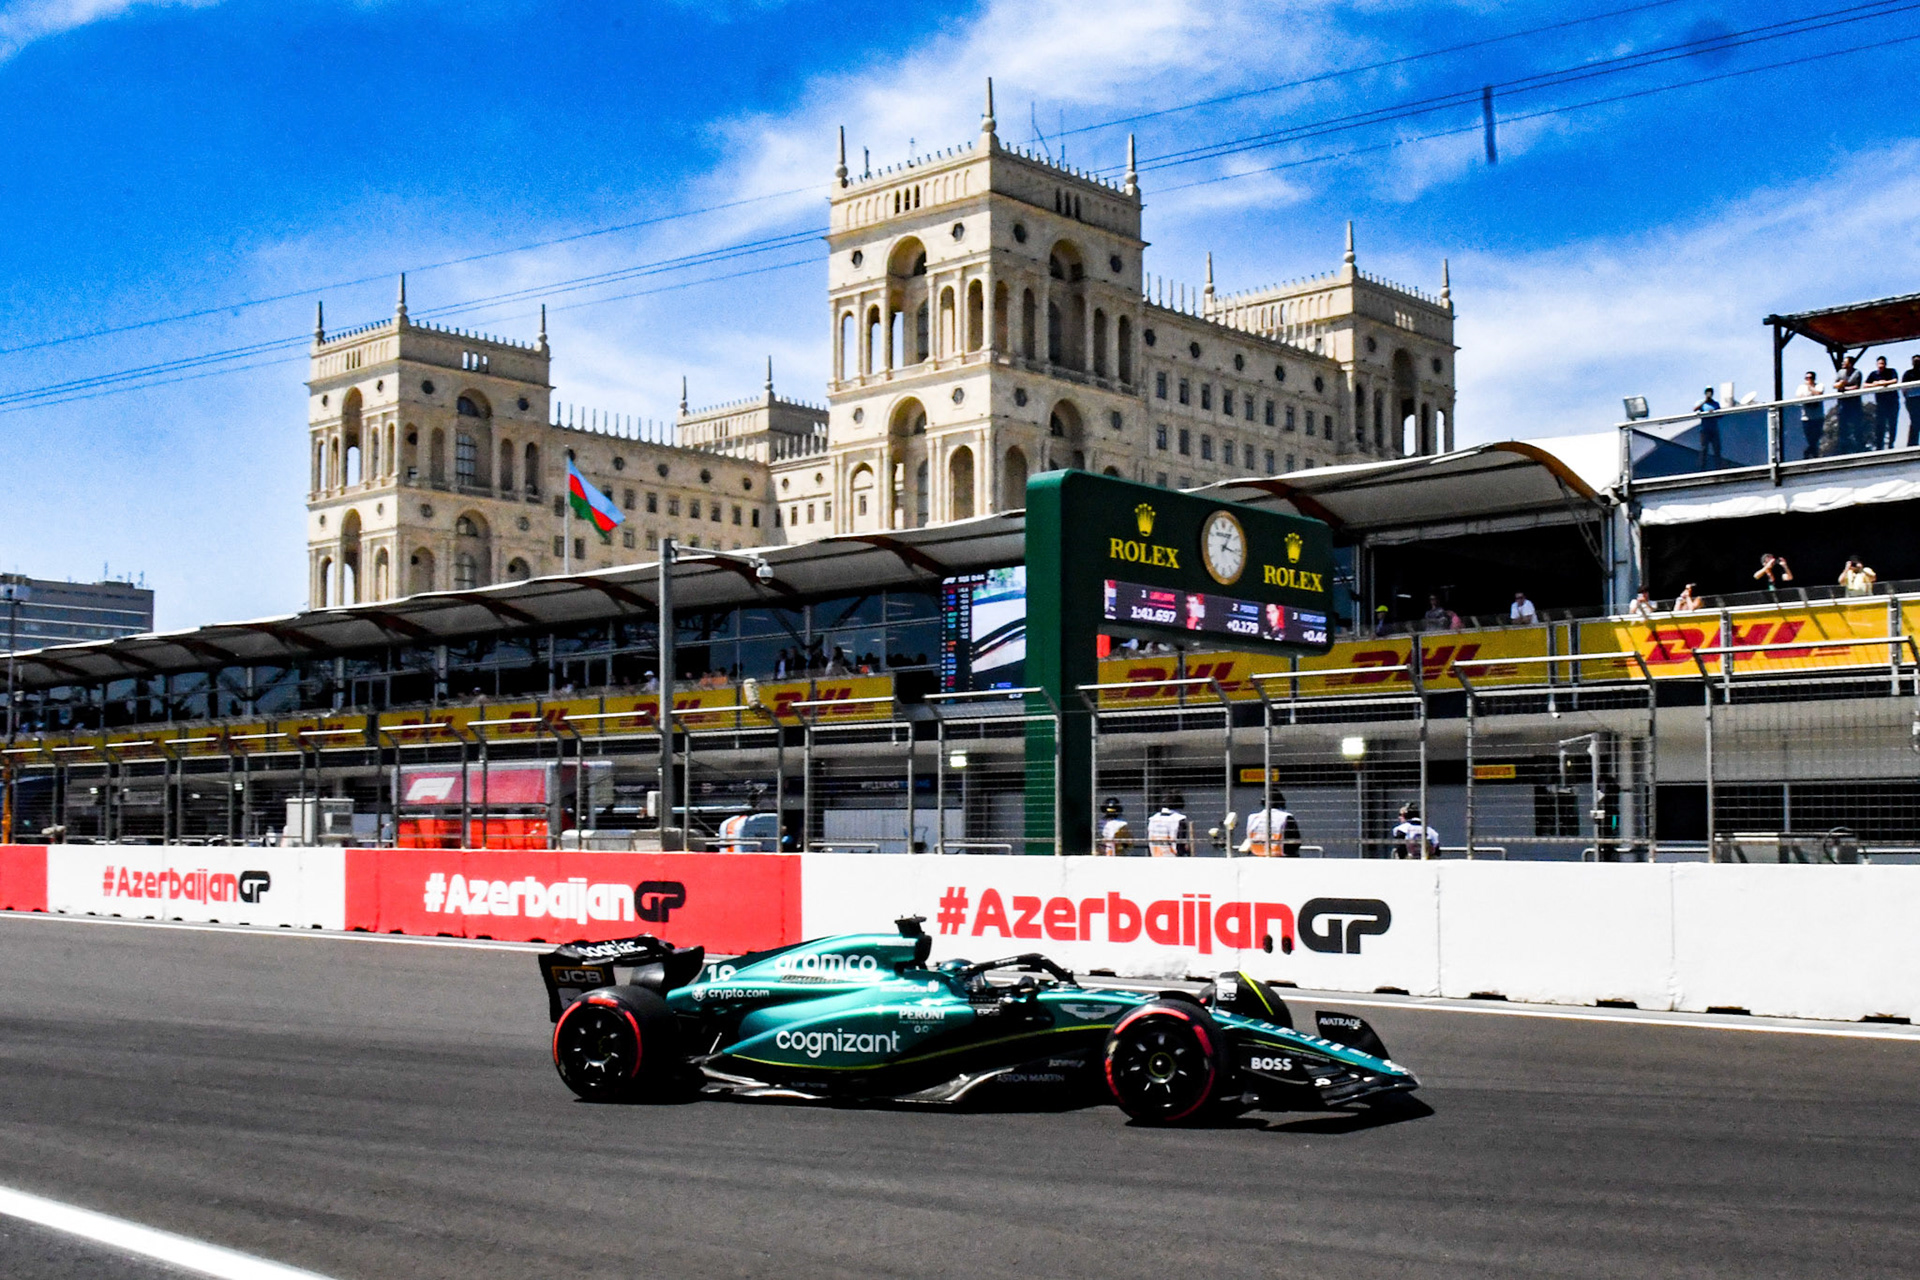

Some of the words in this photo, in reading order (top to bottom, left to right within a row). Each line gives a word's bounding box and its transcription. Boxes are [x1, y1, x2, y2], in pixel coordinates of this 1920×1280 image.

[1109, 537, 1181, 569] ROLEX
[1263, 564, 1324, 593] ROLEX
[1130, 605, 1177, 623] 1:41.697
[1232, 602, 1239, 612] 2
[1226, 619, 1259, 635] +0.179
[1644, 620, 1815, 665] DHL
[1350, 644, 1489, 684] DHL
[1126, 662, 1240, 698] DHL
[774, 688, 855, 717] DHL
[510, 708, 572, 733] DHL
[774, 953, 877, 975] aramco
[559, 970, 602, 983] JCB
[708, 988, 770, 999] crypto.com
[898, 1009, 945, 1020] PERONI
[1318, 1017, 1362, 1028] AVATRADE
[776, 1028, 901, 1058] cognizant
[1251, 1057, 1293, 1071] BOSS
